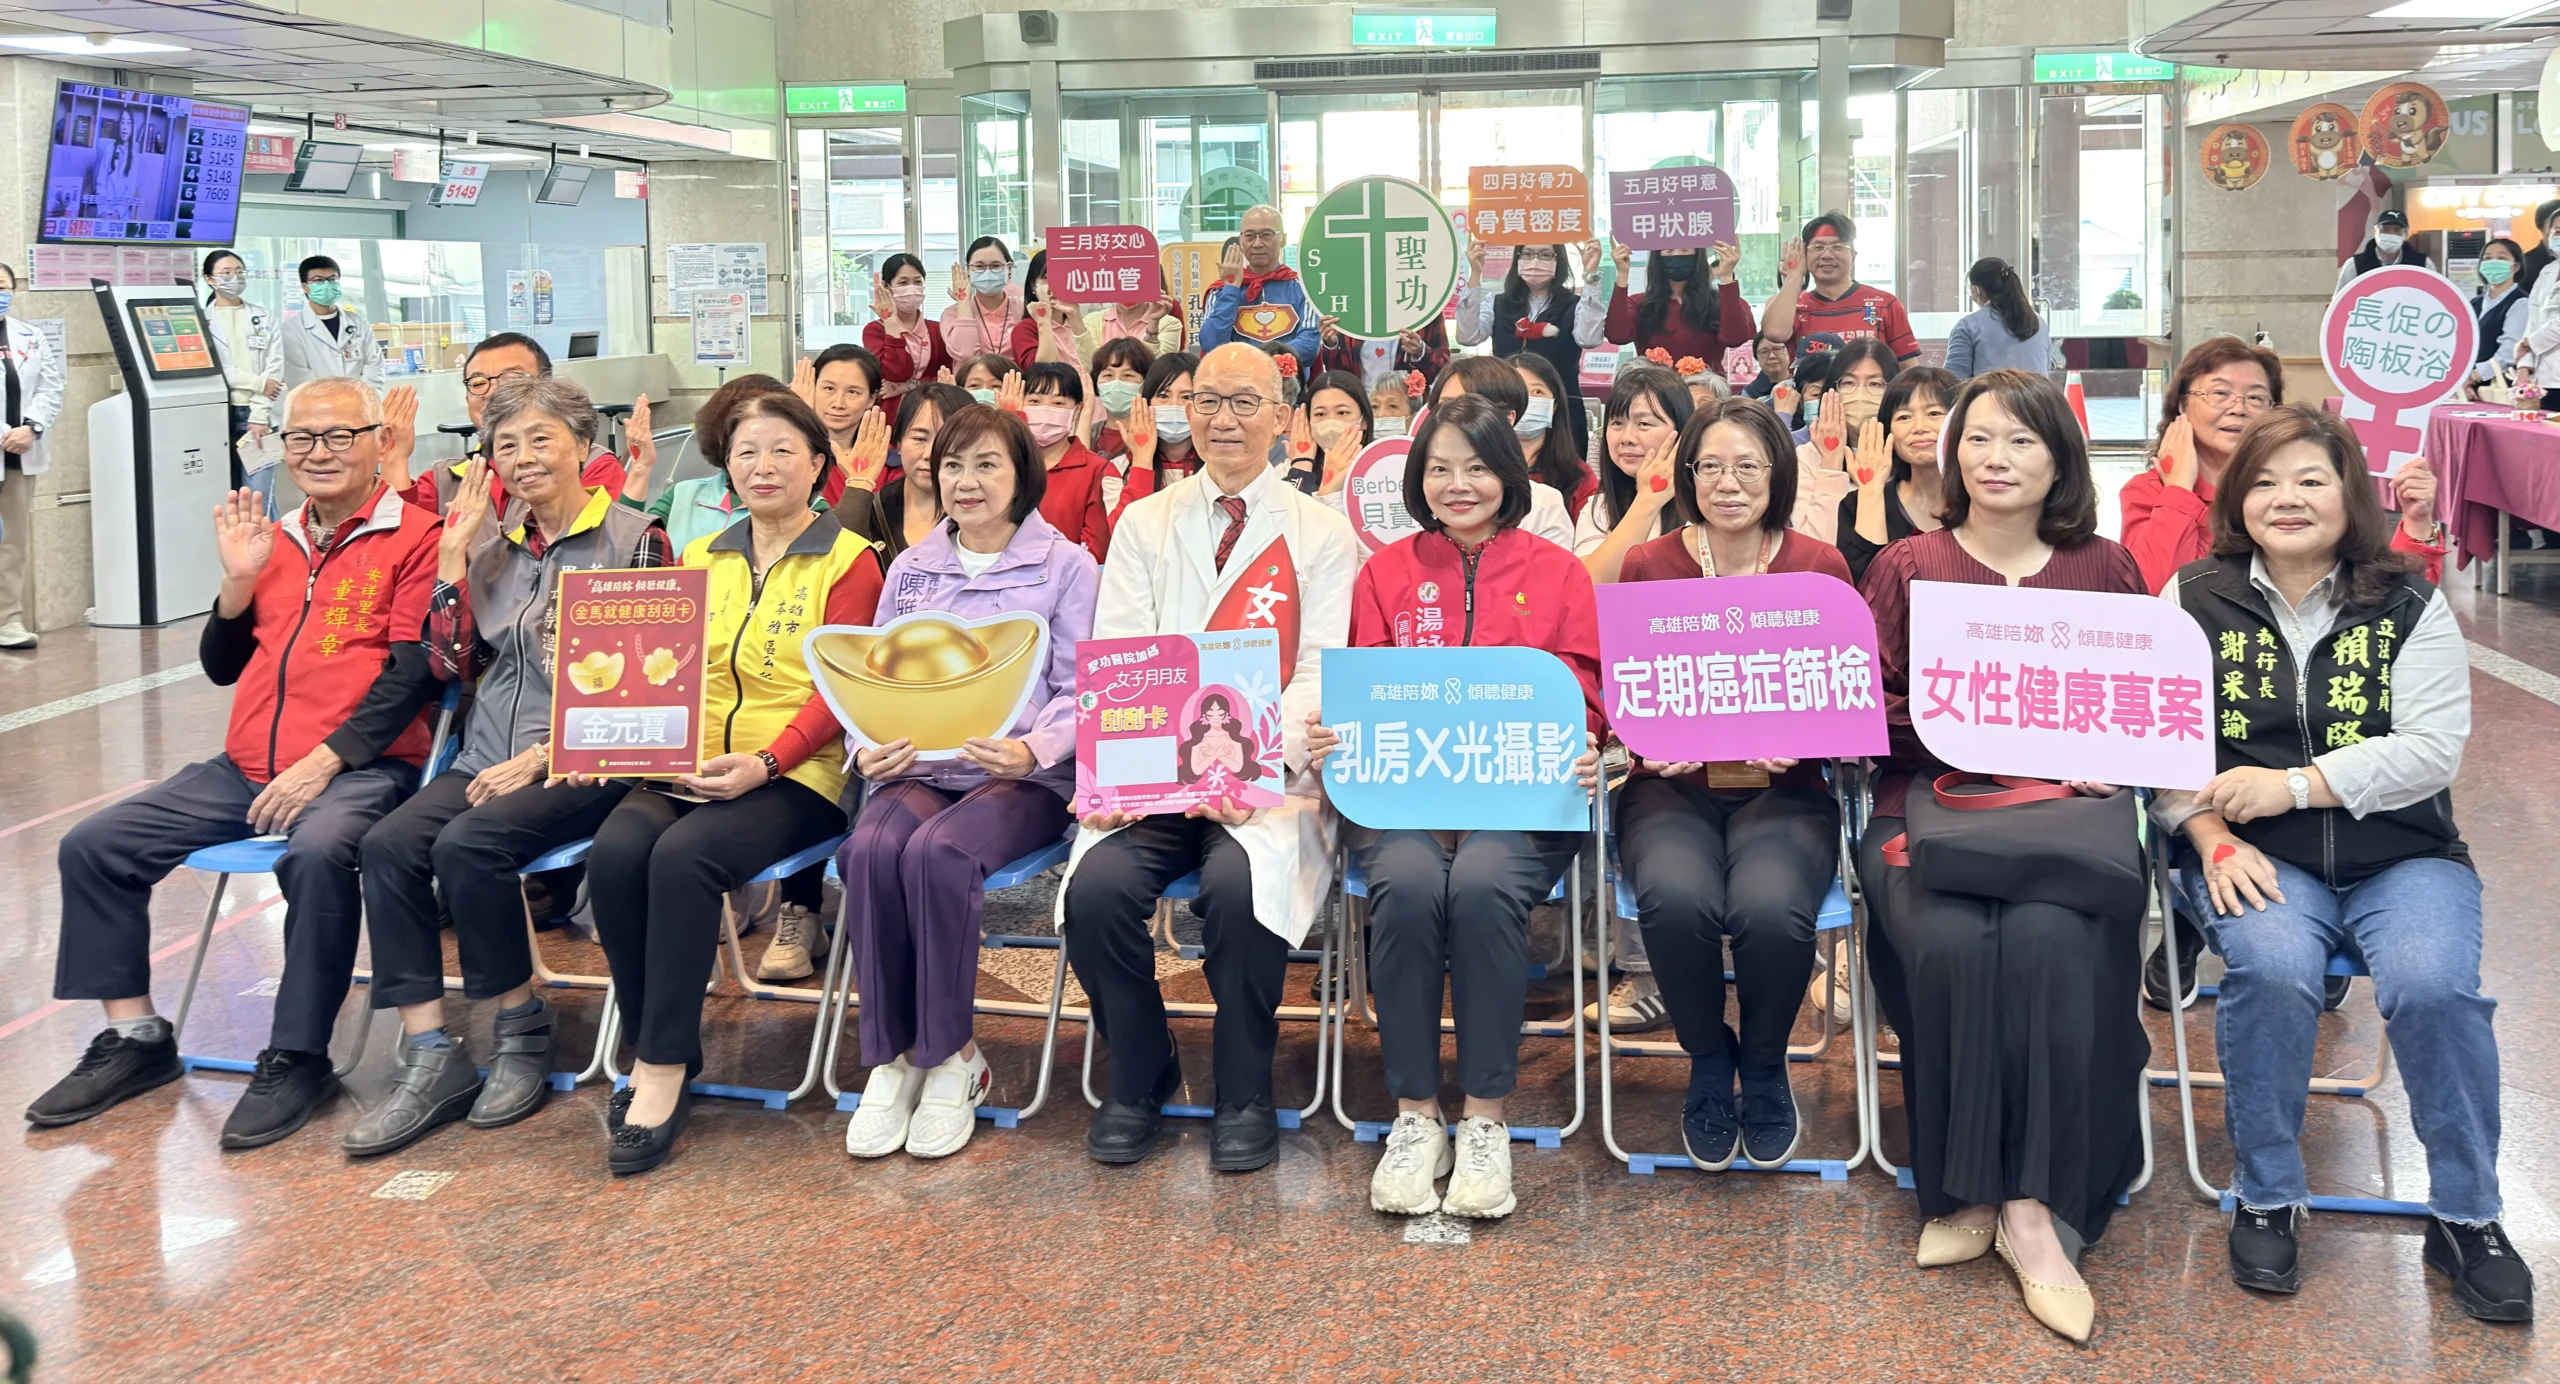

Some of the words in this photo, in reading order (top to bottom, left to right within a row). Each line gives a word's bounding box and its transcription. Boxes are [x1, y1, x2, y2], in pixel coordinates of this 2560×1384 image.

[1367, 32, 1403, 41] EXIT
[2049, 69, 2084, 79] EXIT
[800, 101, 829, 110] EXIT
[335, 113, 346, 130] 3
[191, 132, 200, 143] 2
[210, 132, 237, 148] 5149
[190, 151, 197, 162] 3
[208, 151, 235, 166] 5145
[188, 169, 196, 180] 4
[206, 169, 233, 184] 5148
[1483, 171, 1573, 190] 四月好骨力
[1624, 173, 1718, 195] 五月好甲意
[185, 187, 193, 199] 6
[204, 187, 230, 201] 7609
[446, 184, 477, 200] 5149
[1475, 208, 1582, 234] 骨質密度
[1632, 211, 1714, 239] 甲狀腺
[1060, 232, 1146, 250] 三月好交心
[1066, 267, 1141, 292] 心血管
[1395, 236, 1428, 312] 聖功
[2349, 298, 2456, 338] 長促の
[2342, 337, 2450, 380] 陶板浴
[1363, 500, 1421, 531] 貝寶
[353, 567, 383, 633] 安祥里長
[575, 603, 691, 620] 金馬就健康刮刮卡
[784, 585, 808, 636] 高雄市
[315, 577, 357, 657] 董輝章
[1648, 613, 1720, 634] 高雄陪妳
[1749, 609, 1820, 629] 傾聽健康
[1966, 622, 2044, 643] 高雄陪妳
[2077, 629, 2153, 650] 傾聽健康
[1087, 643, 1160, 675] 聖功醫院加碼
[2255, 626, 2278, 699] 執行長
[2376, 618, 2396, 713] 立法委員
[1115, 667, 1188, 688] 女子月月友
[1370, 682, 1439, 701] 高雄陪妳
[1467, 683, 1534, 701] 傾聽健康
[1612, 644, 1876, 719] 定期癌症篩檢
[2218, 630, 2251, 741] 謝采諭
[2326, 625, 2371, 748] 賴瑞隆
[1921, 657, 2204, 741] 女性健康專案
[580, 711, 668, 744] 金元寶
[1100, 705, 1168, 733] 刮刮卡
[1330, 720, 1576, 785] 乳房X光攝影
